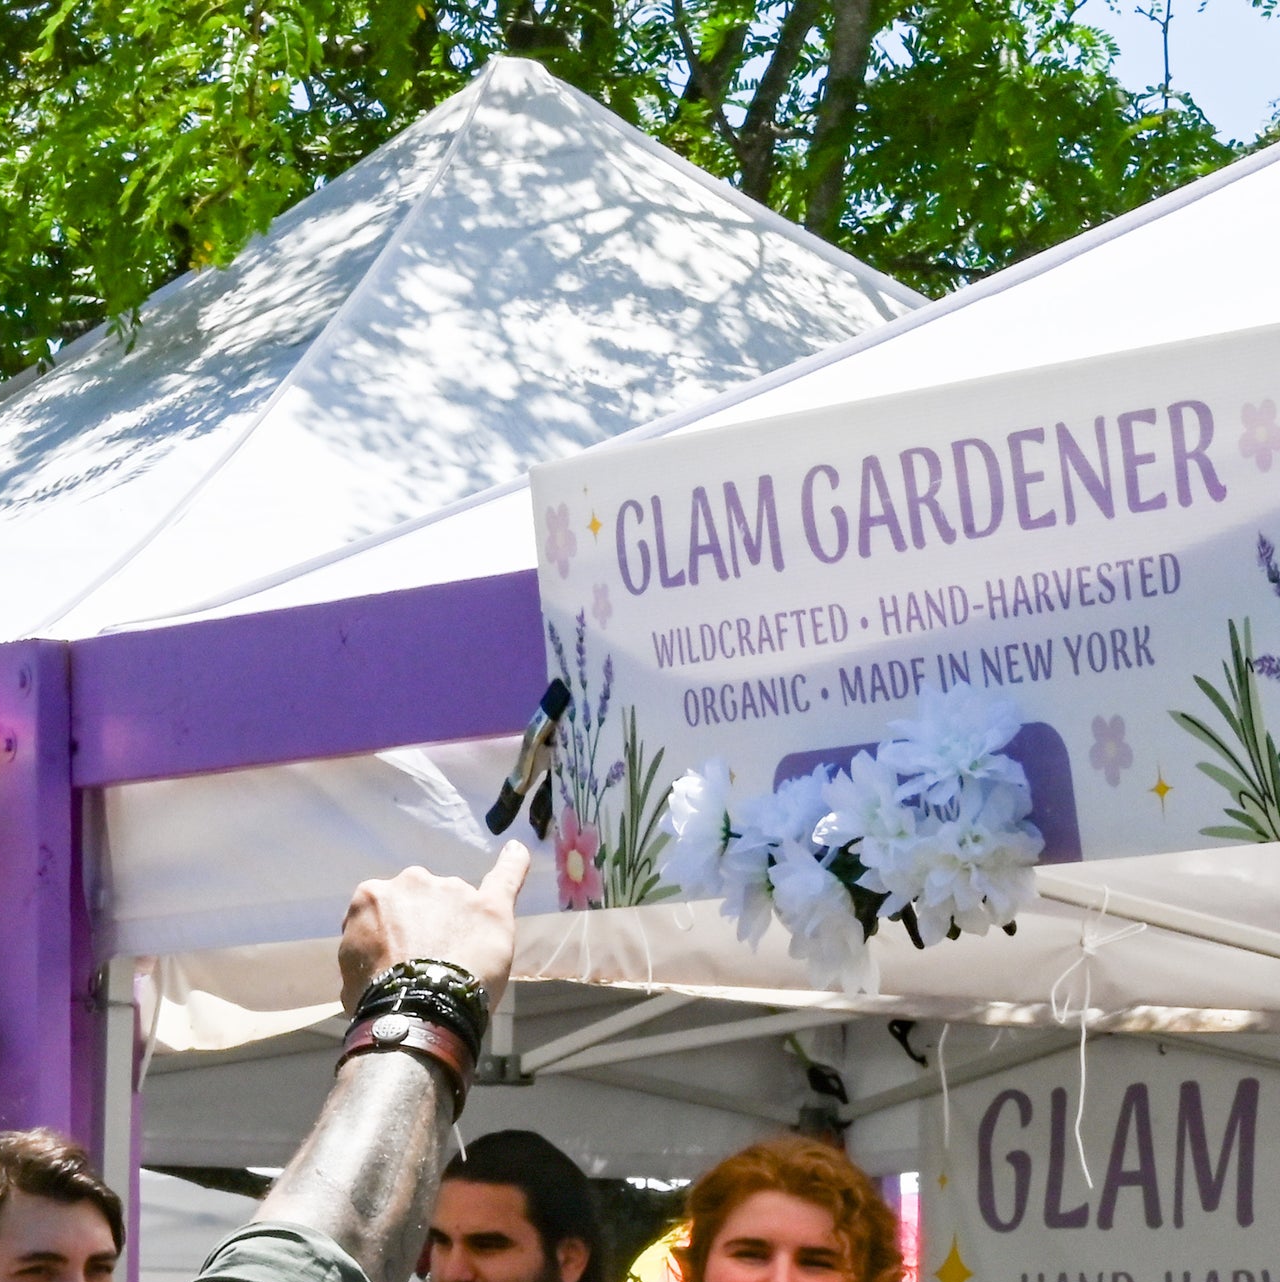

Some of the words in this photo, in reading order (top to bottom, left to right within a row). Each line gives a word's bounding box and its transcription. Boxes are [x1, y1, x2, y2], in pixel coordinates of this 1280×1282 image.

[615, 474, 785, 596] GLAM
[801, 400, 1228, 566] GARDENER
[652, 604, 849, 670] WILDCRAFTED
[879, 552, 1182, 637] HAND-HARVESTED
[683, 673, 810, 727] ORGANIC
[839, 657, 925, 707] MADE
[937, 651, 971, 694] IN
[980, 638, 1055, 689] NEW
[1062, 625, 1156, 676] YORK
[978, 1078, 1260, 1233] GLAM
